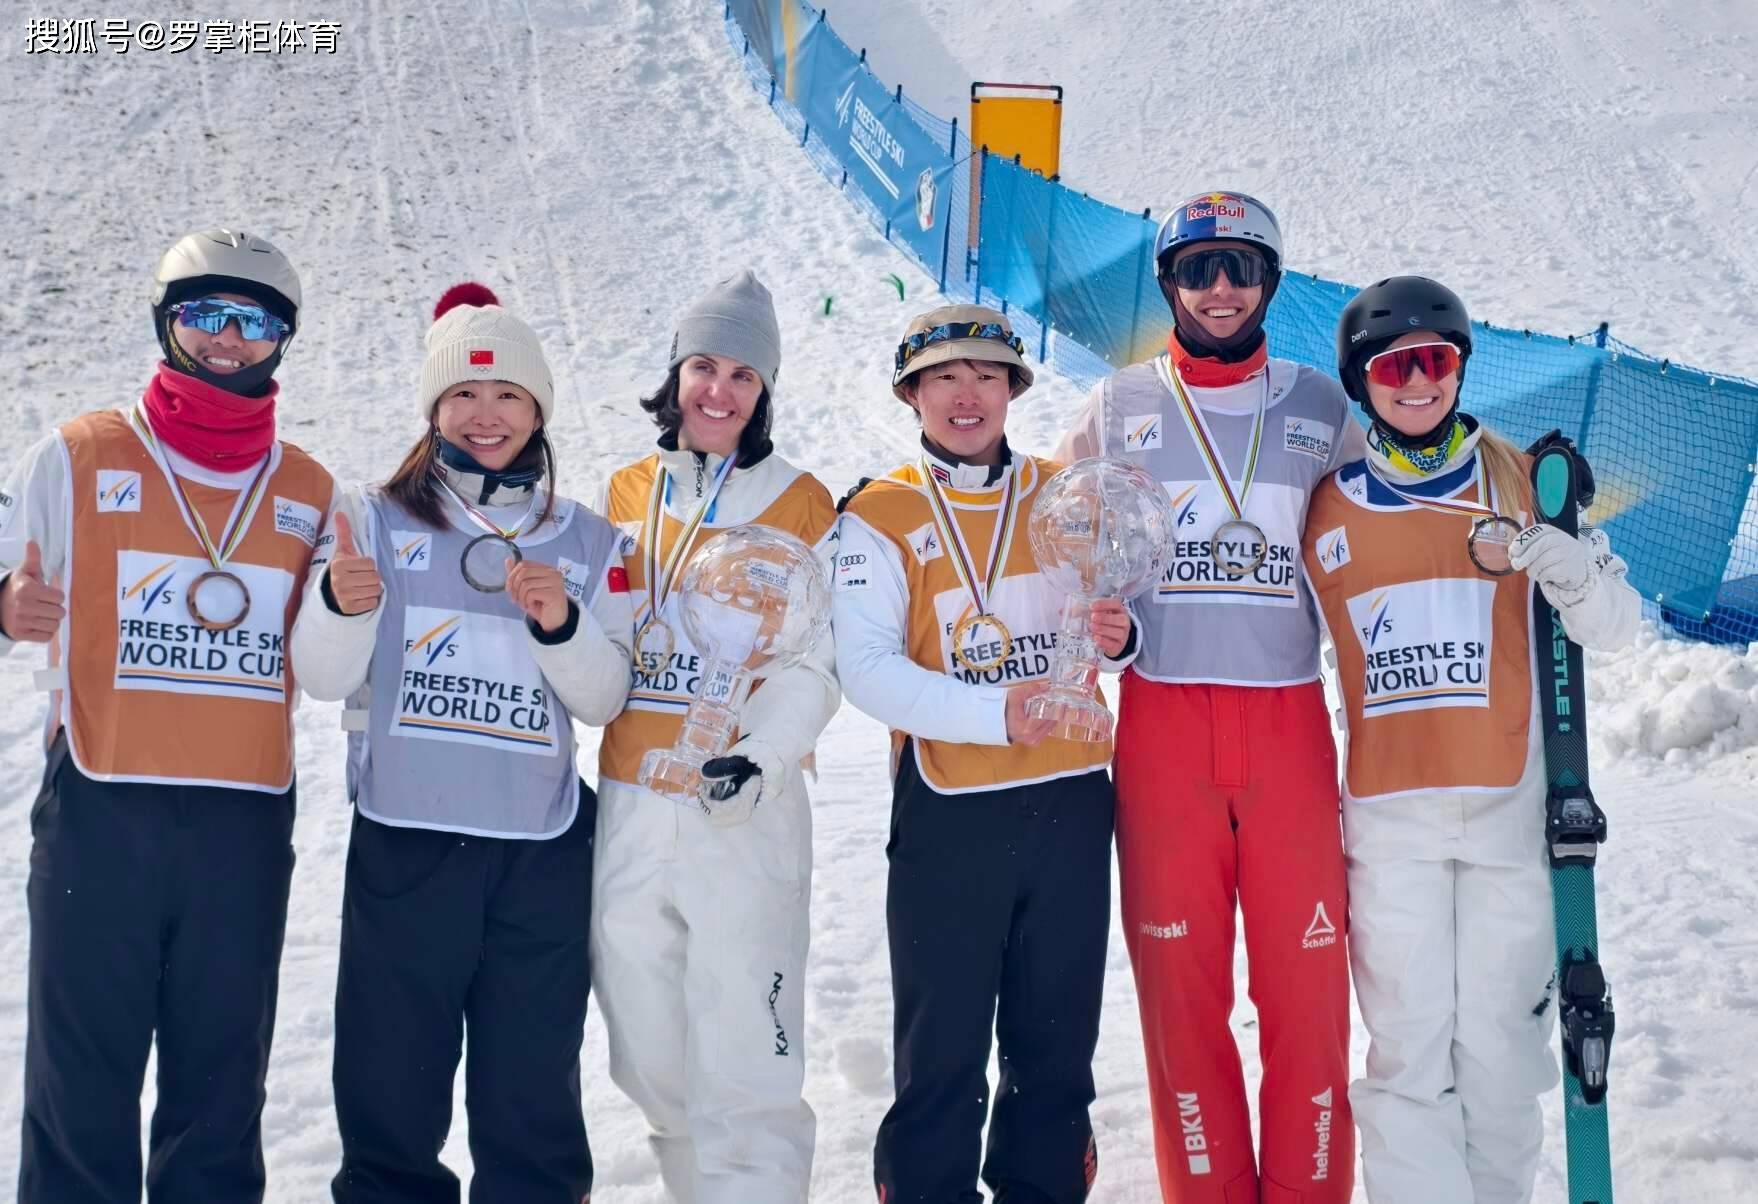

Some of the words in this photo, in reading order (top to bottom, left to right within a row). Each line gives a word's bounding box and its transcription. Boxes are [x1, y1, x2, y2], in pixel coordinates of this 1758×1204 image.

[854, 97, 890, 153] FREESTYLE
[890, 138, 905, 168] SKI
[1187, 204, 1215, 220] Red
[1217, 205, 1245, 218] Bull
[1287, 433, 1321, 444] FREESTYLE
[1287, 439, 1315, 450] WORLD
[1316, 446, 1329, 455] CUP
[1515, 525, 1543, 546] XTM
[1175, 541, 1262, 560] EESTYLE
[1162, 561, 1244, 582] WORLD
[1253, 563, 1295, 585] CUP
[121, 619, 250, 648] FREESTYLE
[257, 632, 283, 652] SK
[120, 641, 228, 671] WORLD
[1367, 642, 1455, 670] REESTYLE
[1463, 641, 1485, 658] SK
[402, 670, 524, 703] FREESTYLE
[1446, 662, 1486, 685] CU
[402, 691, 501, 724] WORLD
[510, 707, 550, 733] CUP
[1175, 1092, 1207, 1152] BKW
[1311, 1109, 1332, 1181] helvetia
